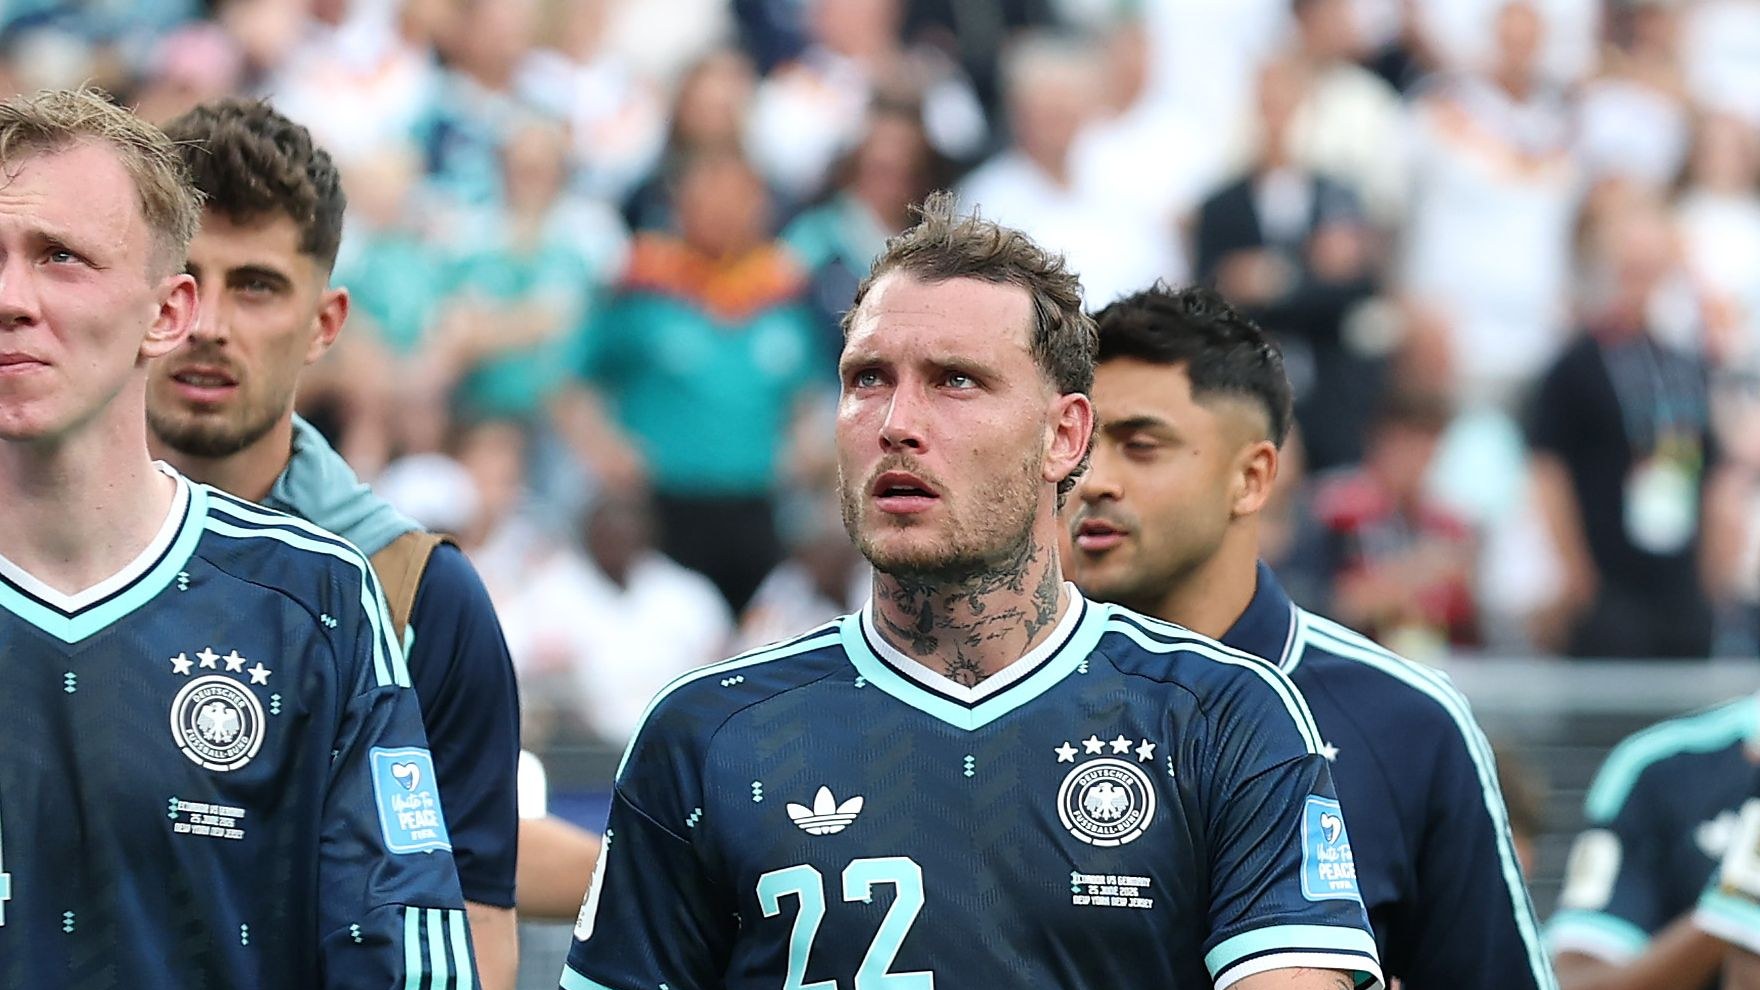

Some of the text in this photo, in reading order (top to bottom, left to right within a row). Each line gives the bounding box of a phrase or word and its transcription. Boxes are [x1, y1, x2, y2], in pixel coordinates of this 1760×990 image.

[192, 687, 246, 709] DEUTSCHER
[1079, 769, 1134, 786] DEUTSCHER
[1073, 809, 1140, 834] FUSSBALL-BUND
